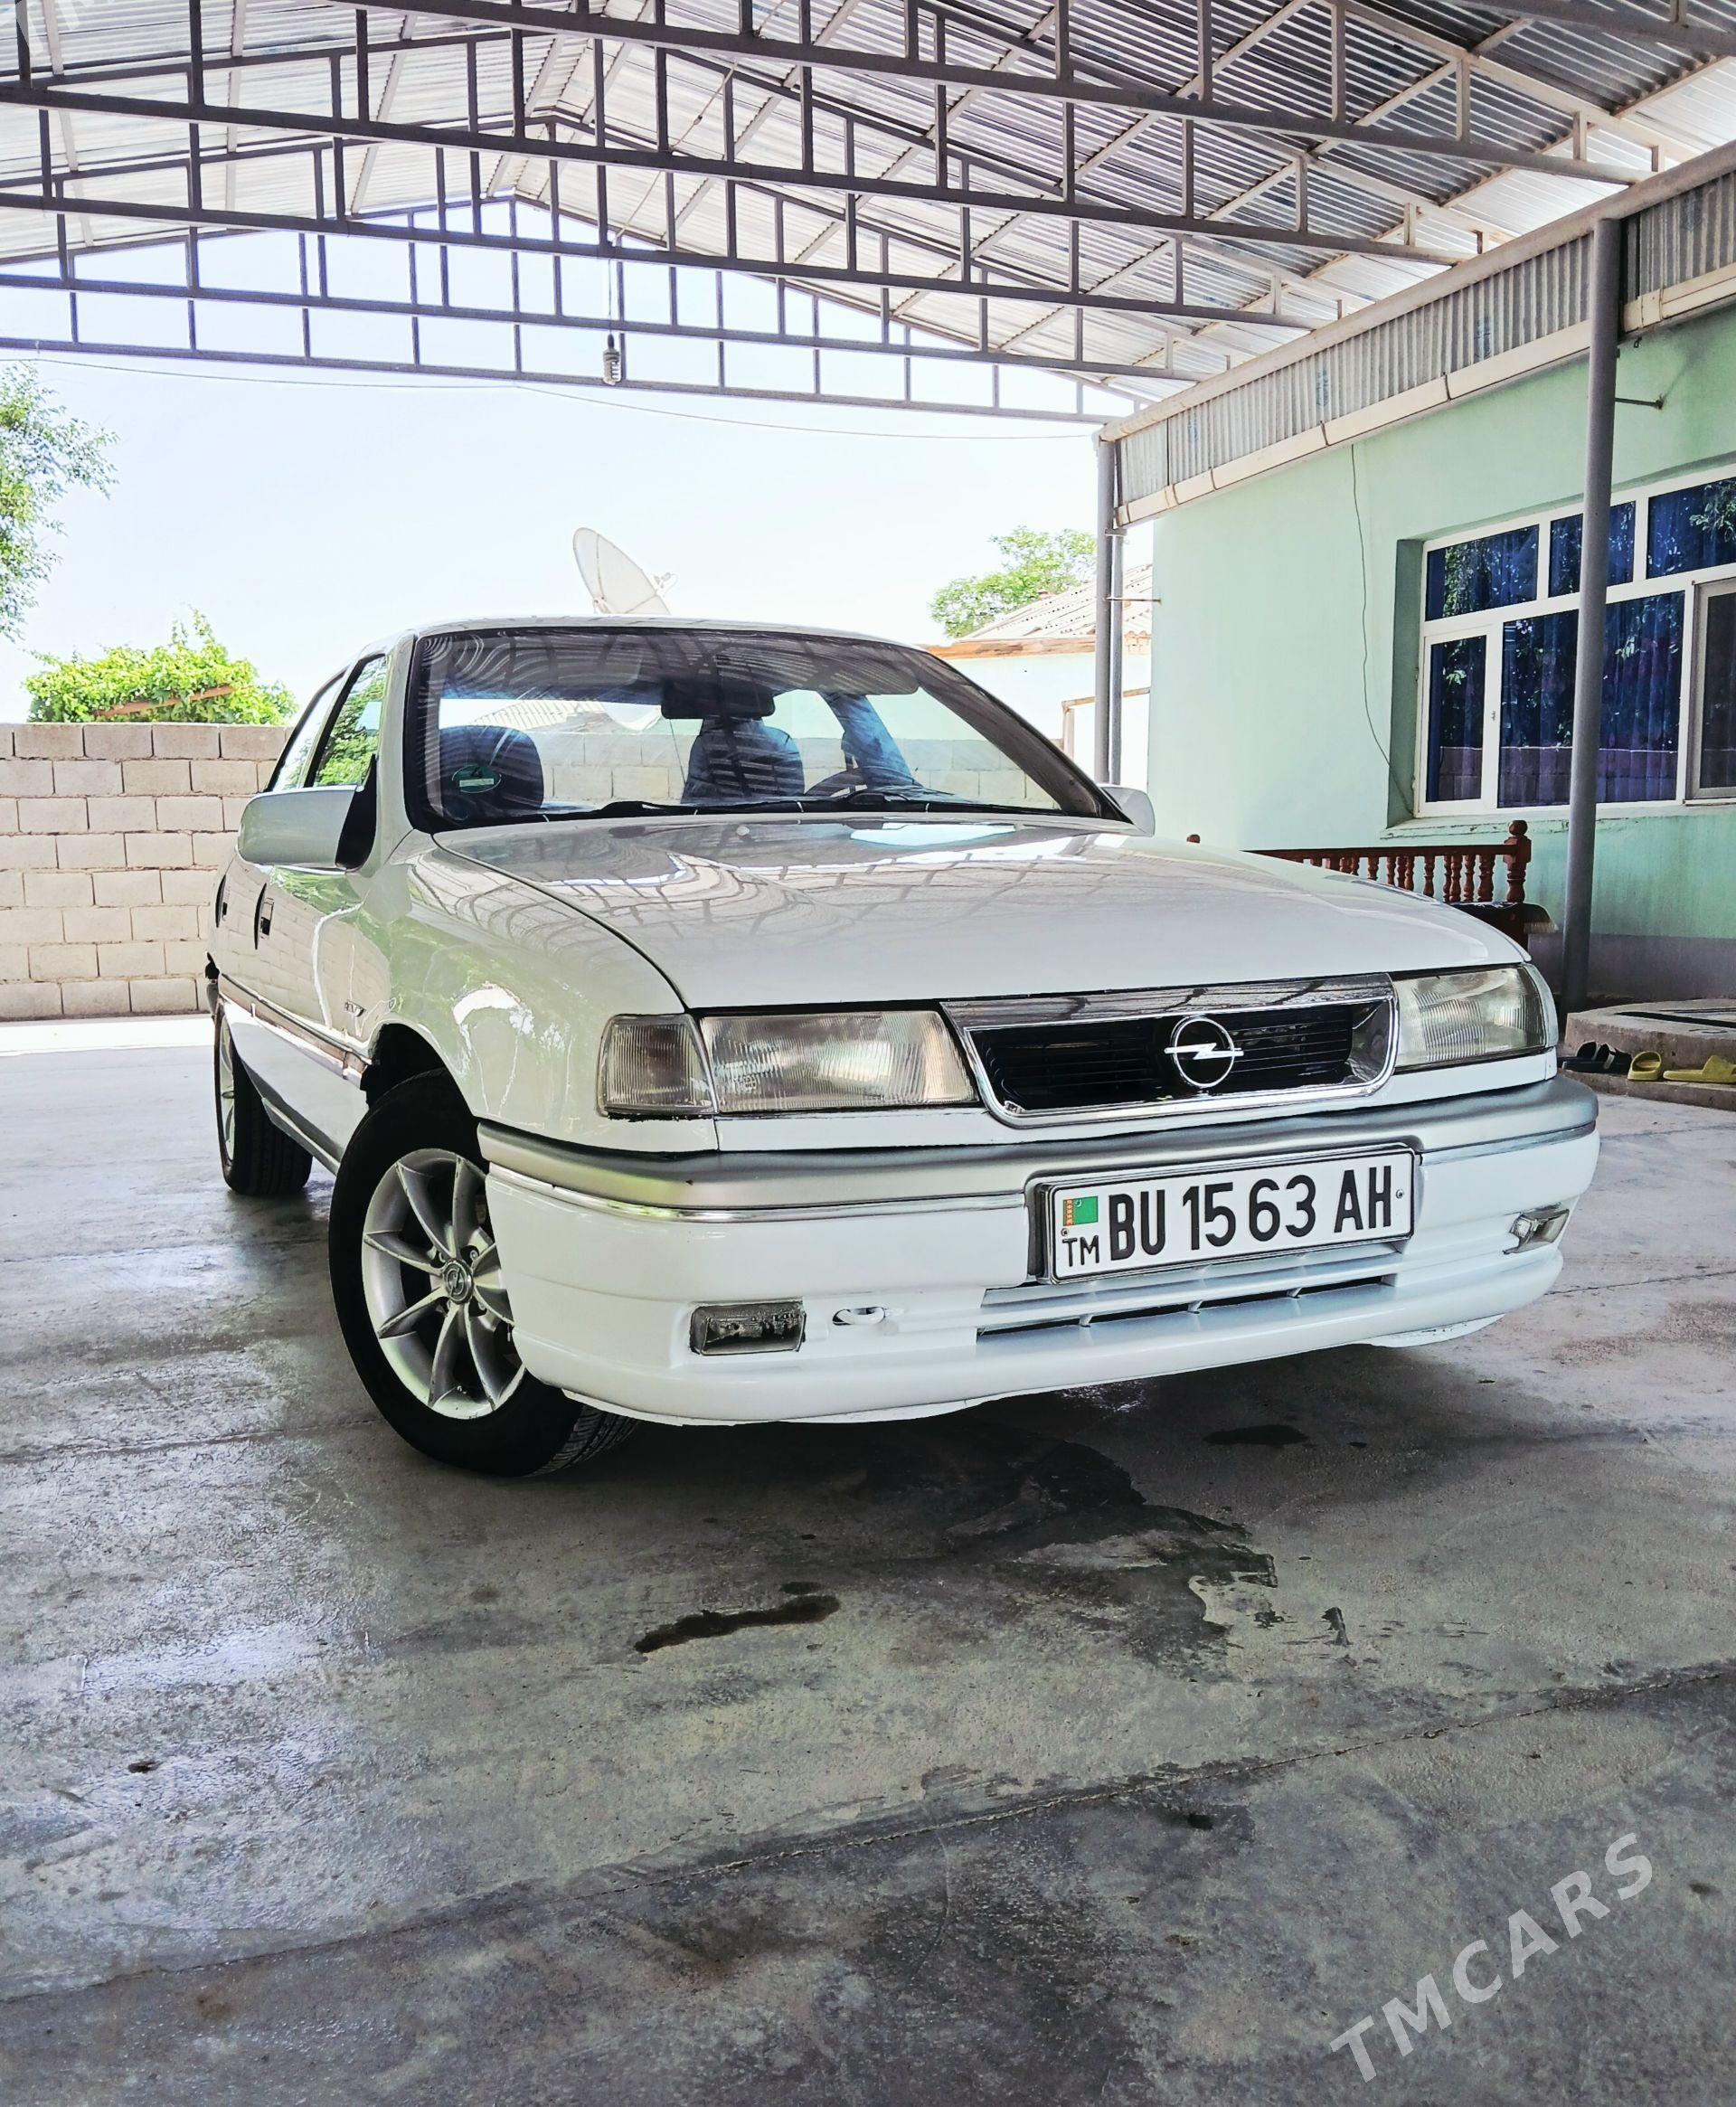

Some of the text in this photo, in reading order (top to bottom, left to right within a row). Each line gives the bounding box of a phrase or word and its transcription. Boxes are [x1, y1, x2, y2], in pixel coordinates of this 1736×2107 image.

[1109, 1189, 1165, 1261] BU
[1334, 1165, 1392, 1233] AH
[1062, 1234, 1100, 1267] TM
